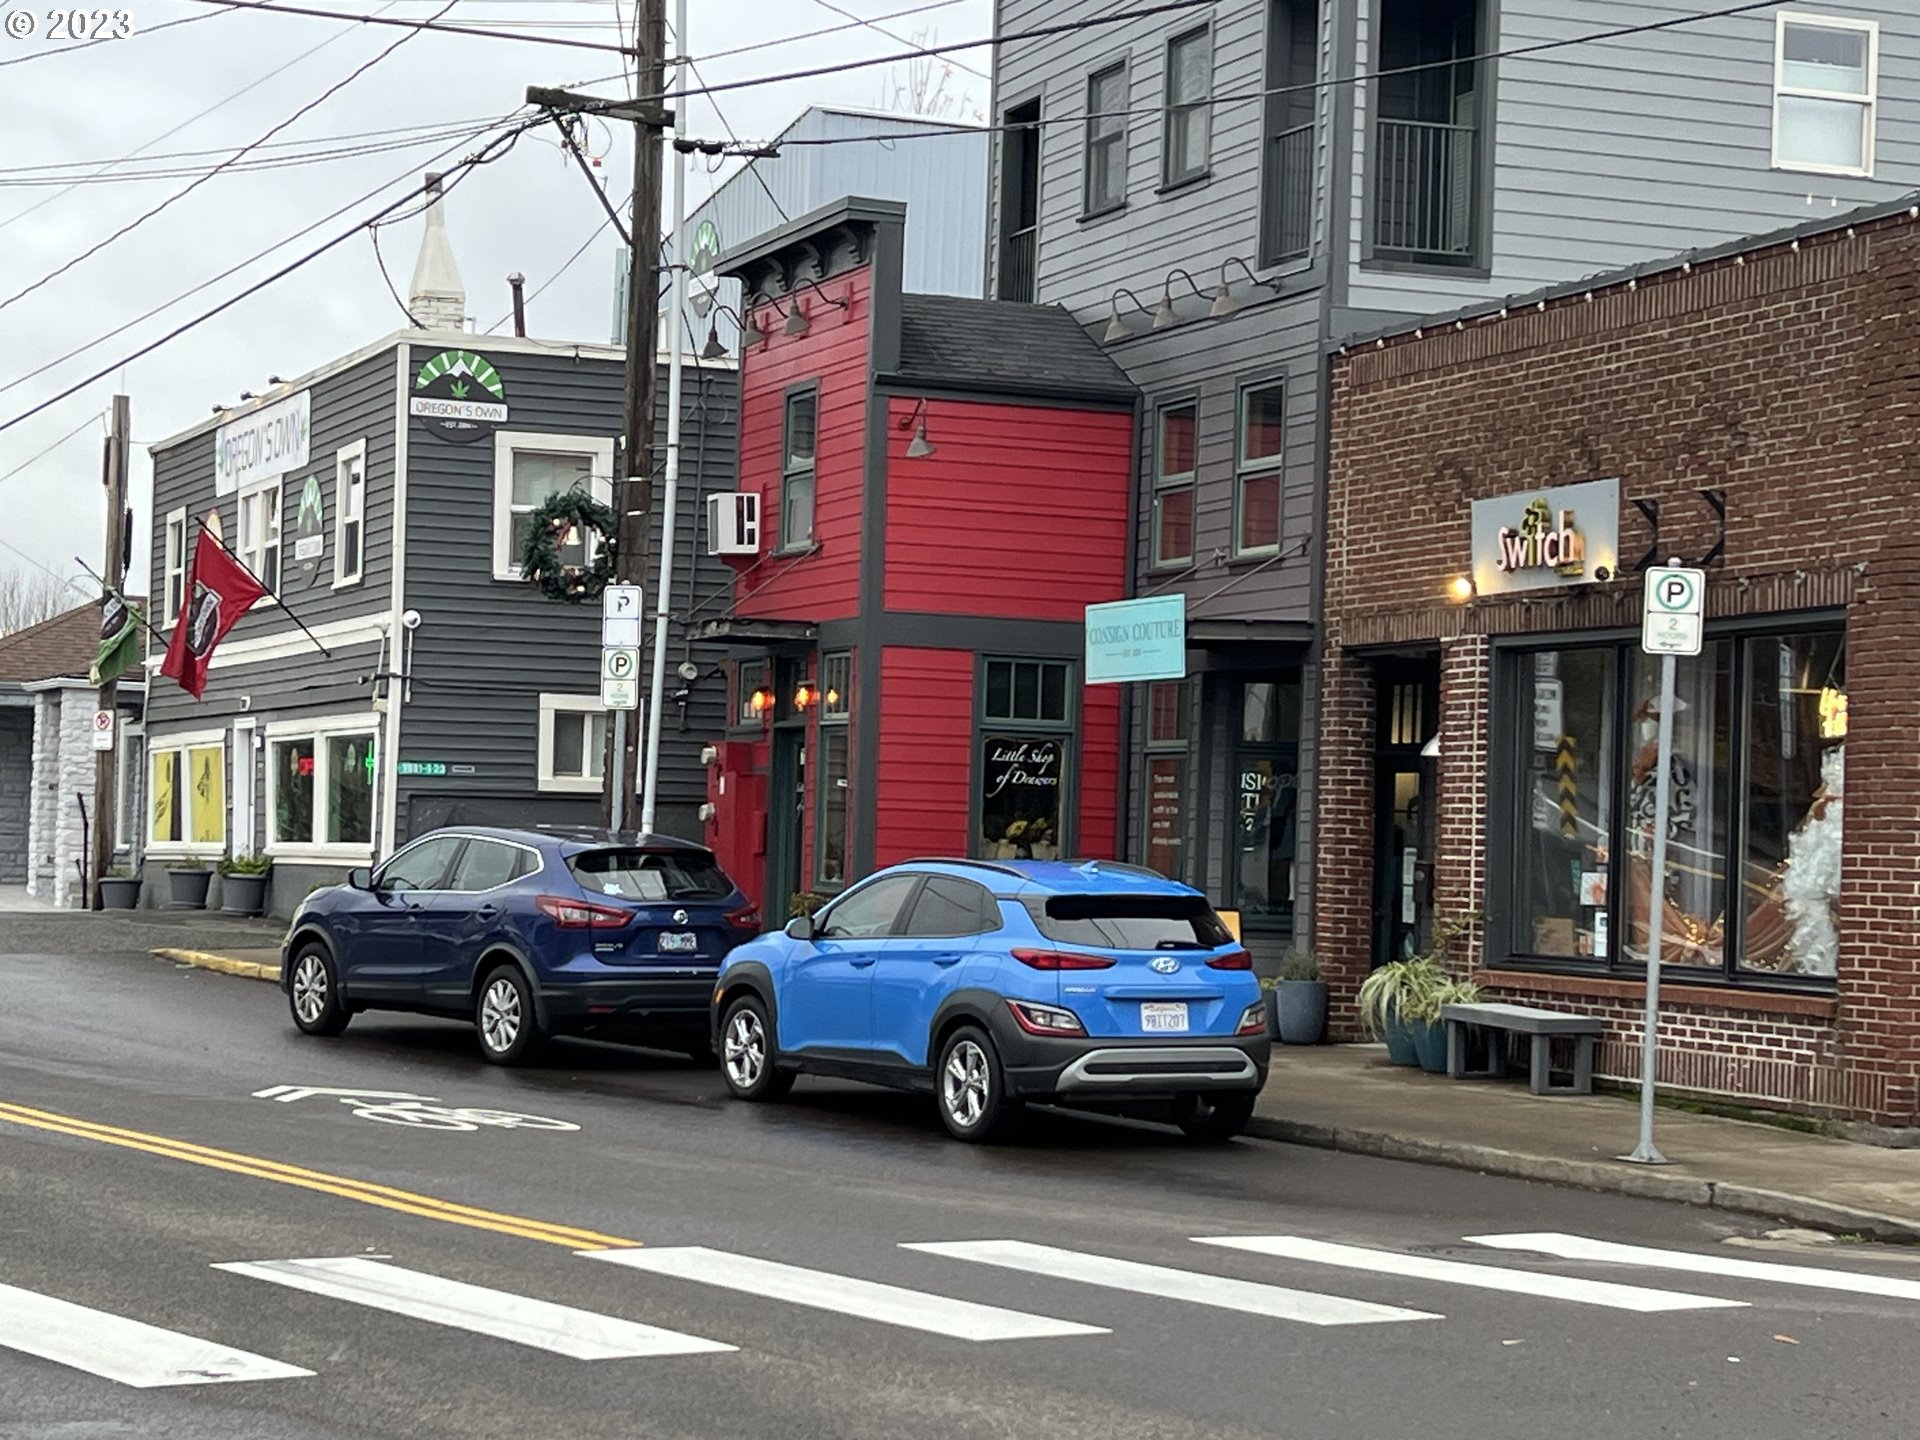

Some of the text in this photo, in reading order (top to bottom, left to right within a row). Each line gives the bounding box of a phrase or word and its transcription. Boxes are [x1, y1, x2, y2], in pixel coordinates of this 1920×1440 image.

[416, 402, 502, 419] OREGON'S OWN
[275, 410, 301, 459] OWN
[1496, 508, 1578, 571] Switch
[1667, 582, 1685, 603] P
[1089, 619, 1181, 646] CONSIGN COUTURE
[1669, 617, 1678, 630] 2
[615, 656, 628, 673] P
[616, 683, 624, 692] 2
[991, 743, 1054, 775] Little Shop
[985, 763, 1019, 798] of
